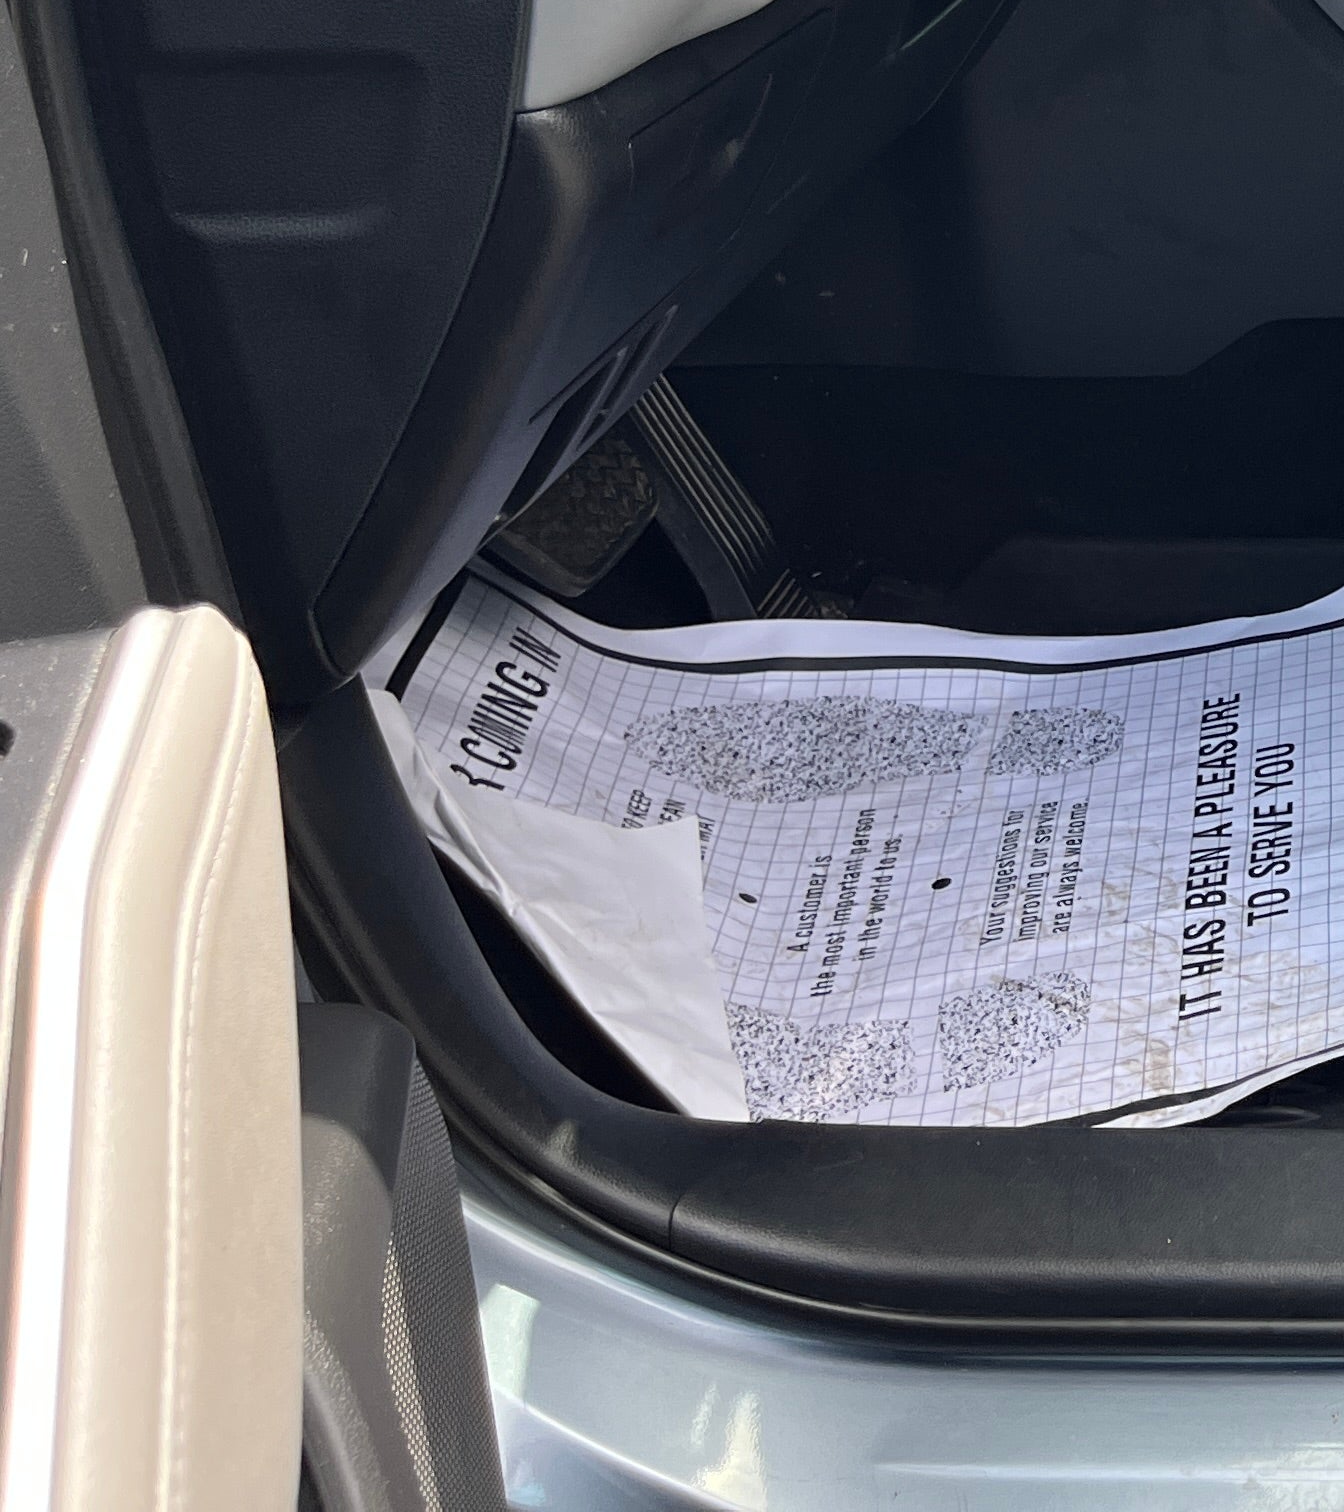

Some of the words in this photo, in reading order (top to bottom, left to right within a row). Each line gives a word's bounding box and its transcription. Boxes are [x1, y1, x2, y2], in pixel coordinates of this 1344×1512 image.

[458, 660, 550, 773] COMING
[508, 627, 562, 672] IN
[1194, 693, 1241, 817] PLEASURE
[1254, 743, 1296, 796] YOU
[626, 788, 654, 820] KEEP
[1003, 809, 1025, 825] for
[1037, 800, 1058, 843] service
[851, 808, 877, 854] person
[1064, 799, 1089, 856] welcome.
[1194, 822, 1233, 839] A
[1249, 803, 1293, 877] SERVE
[811, 853, 832, 867] is
[875, 855, 898, 870] to
[992, 828, 1022, 907] suggestions
[1032, 848, 1048, 867] our
[829, 859, 865, 926] important
[870, 876, 894, 913] world
[1053, 860, 1083, 907] always
[1186, 846, 1231, 909] BEEN
[796, 873, 827, 938] customer
[1016, 874, 1049, 941] improving
[1053, 912, 1072, 933] are
[1248, 888, 1291, 925] TO
[858, 919, 883, 941] the
[981, 911, 1006, 945] Your
[788, 942, 809, 952] A
[823, 930, 847, 966] most
[854, 946, 877, 960] in
[1182, 920, 1226, 979] HAS
[811, 972, 837, 996] the
[1179, 990, 1222, 1021] IT
